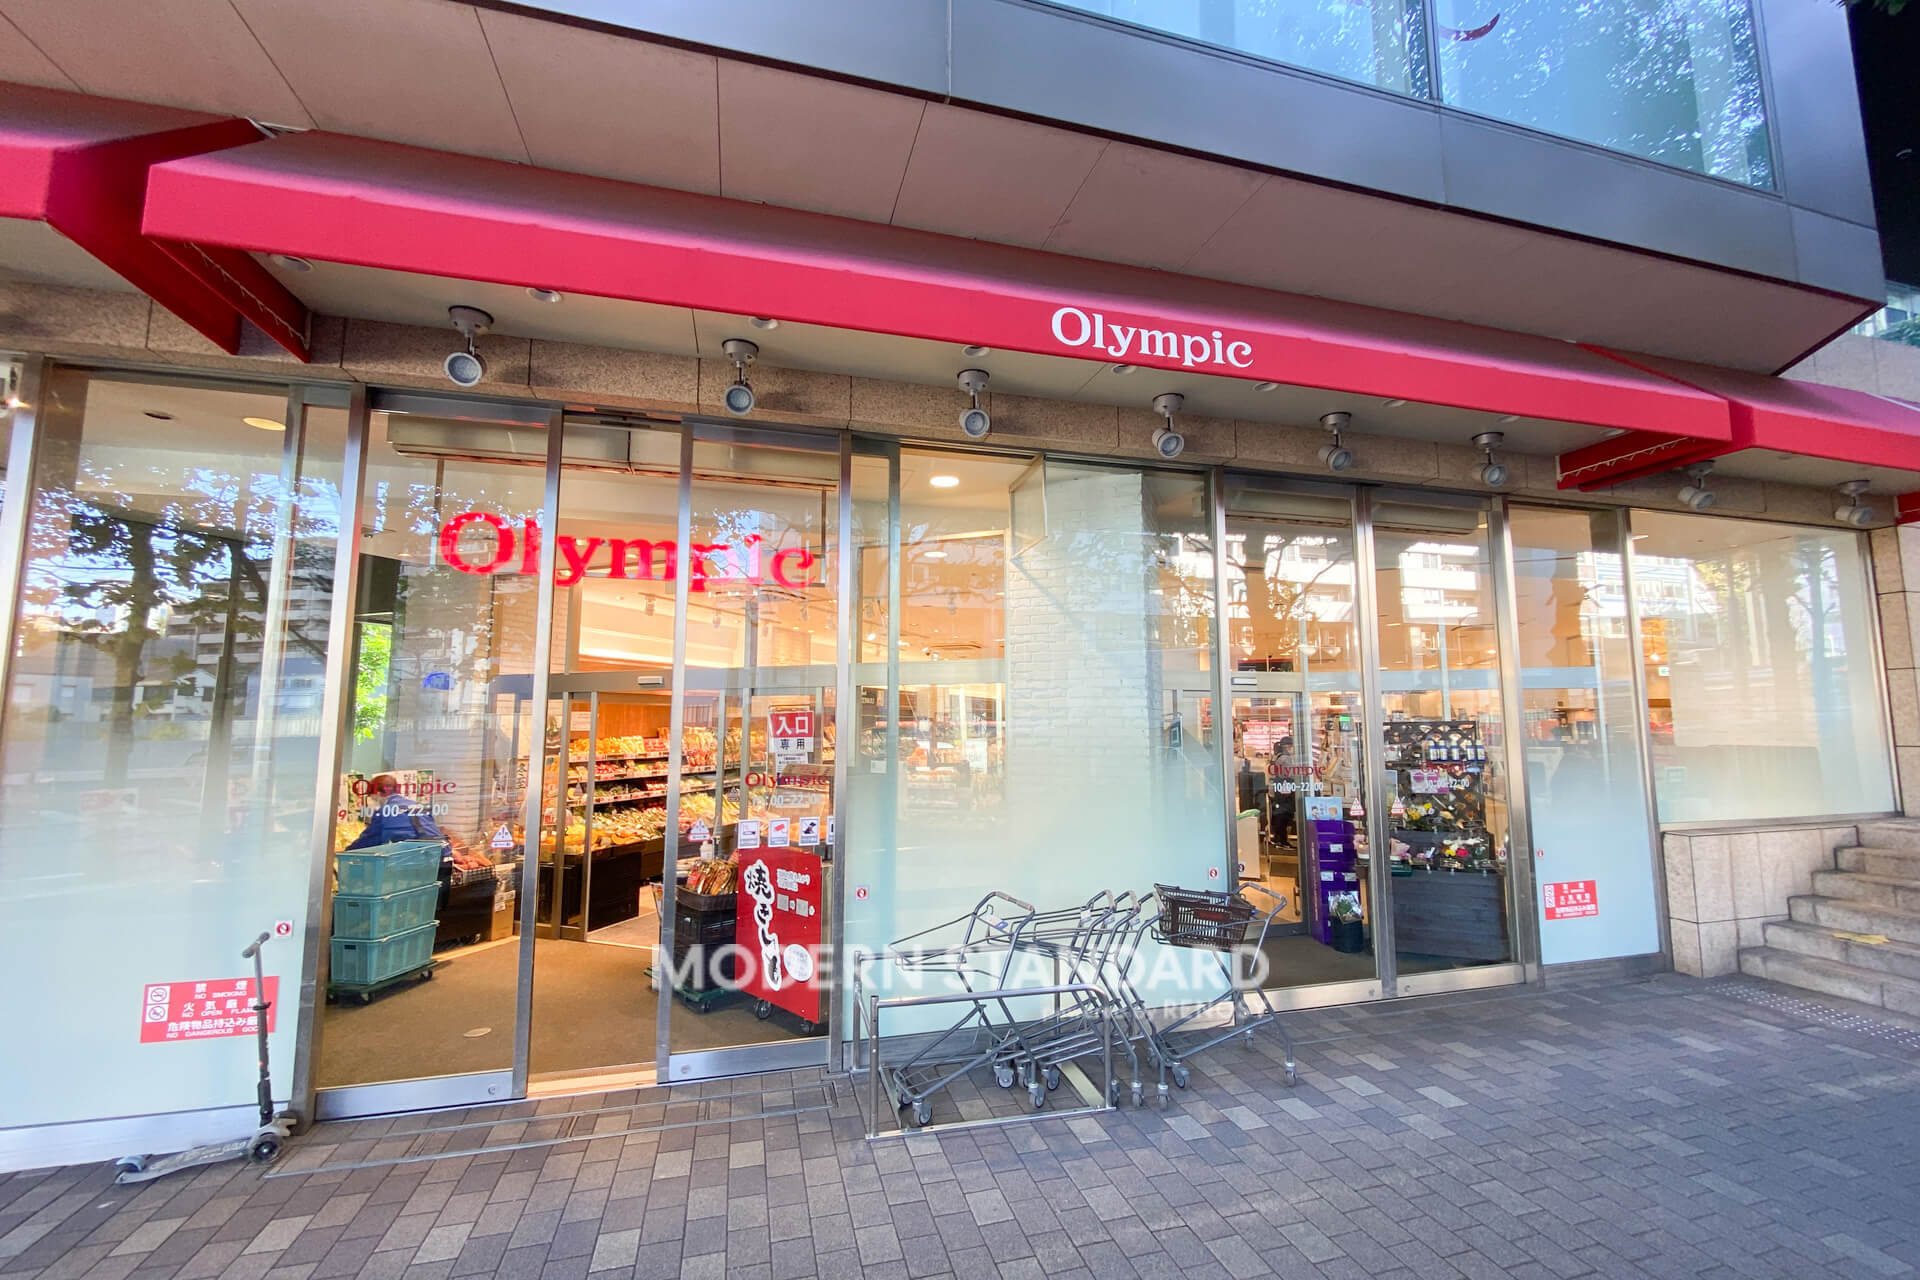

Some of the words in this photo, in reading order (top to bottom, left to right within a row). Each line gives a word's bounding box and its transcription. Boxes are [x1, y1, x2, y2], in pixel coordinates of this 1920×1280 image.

[1052, 307, 1254, 368] Olympic
[776, 716, 809, 735] 入口
[780, 738, 805, 750] 専用
[1267, 763, 1326, 780] Olympic
[352, 778, 457, 797] Olympic
